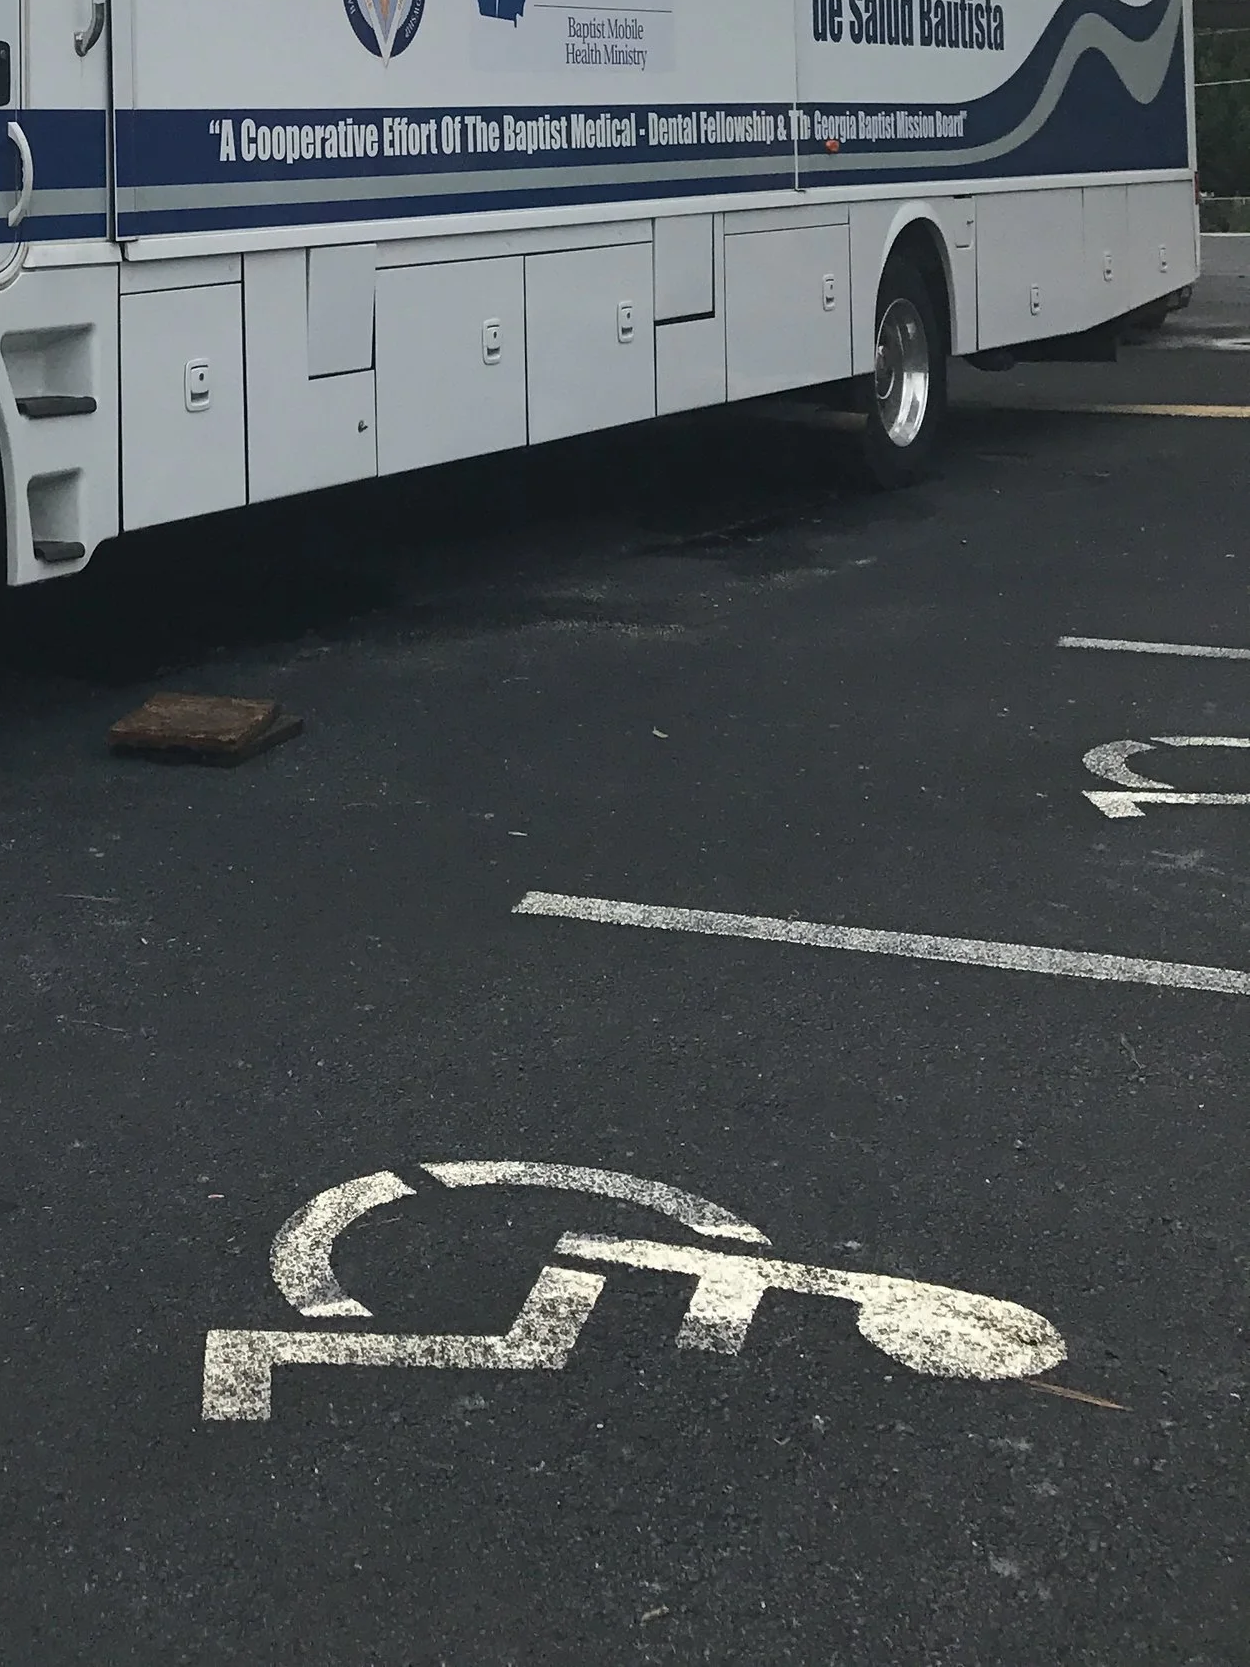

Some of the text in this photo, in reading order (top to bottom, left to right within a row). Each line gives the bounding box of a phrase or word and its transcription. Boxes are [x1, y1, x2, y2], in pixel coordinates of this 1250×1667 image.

[567, 16, 644, 44] Baptist Mobile
[565, 42, 648, 71] Health Ministry
[241, 117, 378, 164] Cooperative
[382, 116, 438, 157] Effort
[441, 115, 462, 155] Of
[464, 115, 500, 153] The
[503, 114, 568, 155] Baptist
[570, 113, 636, 149] Medical
[648, 111, 698, 146] Dental
[699, 110, 775, 145] Fellowship
[777, 114, 788, 141] &
[814, 110, 857, 144] Georgia
[858, 110, 895, 142] Baptist
[896, 110, 935, 139] Mission
